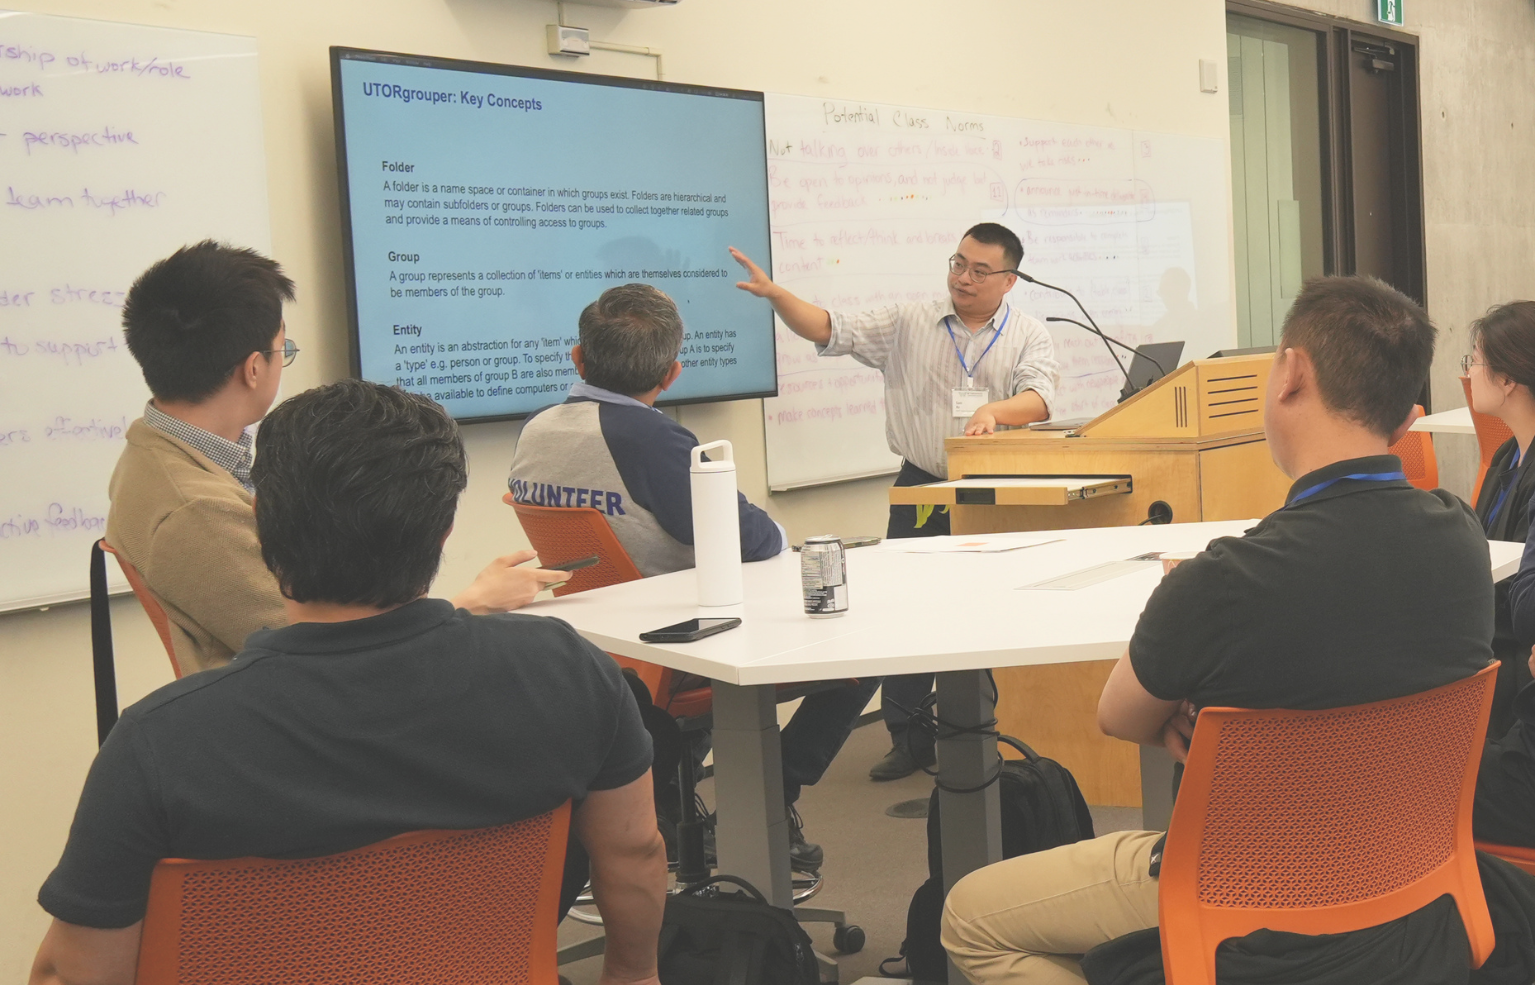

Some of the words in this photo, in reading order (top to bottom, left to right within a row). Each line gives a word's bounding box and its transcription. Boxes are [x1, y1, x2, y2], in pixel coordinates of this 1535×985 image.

[66, 50, 93, 72] of
[96, 57, 191, 79] work/role
[0, 81, 43, 97] work
[363, 82, 456, 105] UTORgrouper:
[460, 90, 484, 109] Key
[487, 93, 542, 113] Concepts
[823, 102, 879, 126] Potential
[892, 110, 929, 129] Class
[946, 115, 984, 132] Norms
[23, 125, 139, 156] perspective
[769, 139, 792, 156] Not
[800, 137, 848, 164] talking
[382, 160, 415, 173] Folder
[383, 180, 392, 191] A
[392, 181, 420, 193] folder
[421, 182, 430, 193] is
[432, 184, 438, 193] a
[440, 185, 466, 194] name
[468, 186, 494, 197] space
[496, 187, 506, 196] or
[507, 187, 546, 197] container
[548, 187, 556, 197] in
[557, 188, 580, 198] which
[581, 190, 608, 201] groups
[610, 190, 630, 200] exist.
[631, 190, 659, 201] Folders
[660, 193, 672, 202] are
[673, 192, 712, 203] hierarchical
[714, 194, 726, 203] and
[384, 199, 405, 211] may
[407, 198, 441, 209] contain
[443, 199, 489, 211] subfolders
[491, 202, 500, 211] or
[502, 203, 534, 214] groups.
[535, 201, 566, 213] Folders
[567, 205, 582, 213] can
[584, 203, 594, 214] be
[596, 204, 615, 214] used
[616, 205, 624, 214] to
[625, 205, 650, 215] collect
[650, 206, 680, 218] together
[680, 206, 704, 216] related
[705, 209, 729, 219] groups
[385, 214, 404, 224] and
[406, 214, 440, 227] provide
[442, 217, 449, 225] a
[451, 217, 481, 226] means
[483, 215, 492, 226] of
[493, 216, 537, 230] controlling
[538, 219, 567, 228] access
[568, 218, 577, 228] to
[578, 220, 607, 231] groups.
[388, 251, 420, 264] Group
[389, 270, 397, 282] A
[398, 273, 426, 284] group
[428, 271, 476, 283] represents
[478, 272, 484, 281] a
[486, 270, 526, 281] collection
[528, 269, 536, 280] of
[537, 269, 563, 280] 'items'
[565, 272, 573, 280] or
[575, 270, 603, 280] entities
[604, 269, 626, 279] which
[627, 271, 640, 279] are
[641, 269, 682, 279] themselves
[683, 268, 720, 278] considered
[721, 269, 728, 278] to
[390, 287, 403, 298] be
[405, 287, 448, 298] members
[450, 286, 460, 297] of
[461, 286, 476, 296] the
[477, 287, 505, 299] group.
[393, 324, 422, 337] Entity
[694, 330, 704, 340] An
[705, 330, 724, 341] entity
[724, 329, 737, 338] has
[394, 344, 408, 355] An
[410, 343, 435, 356] entity
[437, 342, 446, 353] is
[447, 344, 459, 352] an
[461, 340, 508, 352] abstraction
[510, 339, 522, 349] for
[524, 340, 540, 351] any
[541, 336, 562, 347] 'item'
[564, 336, 580, 346] whic
[689, 344, 696, 354] A
[696, 344, 702, 354] is
[703, 344, 710, 353] to
[711, 342, 735, 354] specify
[395, 363, 402, 371] a
[404, 359, 428, 373] 'type'
[430, 360, 448, 372] e.g.
[450, 358, 481, 371] person
[482, 358, 492, 366] or
[494, 356, 521, 368] group.
[522, 353, 533, 364] To
[534, 351, 564, 365] specify
[681, 359, 699, 368] other
[700, 357, 718, 368] entity
[719, 357, 738, 368] types
[416, 375, 428, 386] all
[430, 373, 472, 385] members
[474, 371, 483, 382] of
[485, 372, 510, 384] group
[511, 369, 518, 380] B
[520, 370, 534, 379] are
[536, 368, 554, 378] also
[435, 388, 474, 401] available
[476, 388, 485, 398] to
[487, 385, 513, 397] define
[515, 383, 558, 396] computers
[560, 383, 568, 392] or
[508, 478, 626, 516] VOLUNTEER
